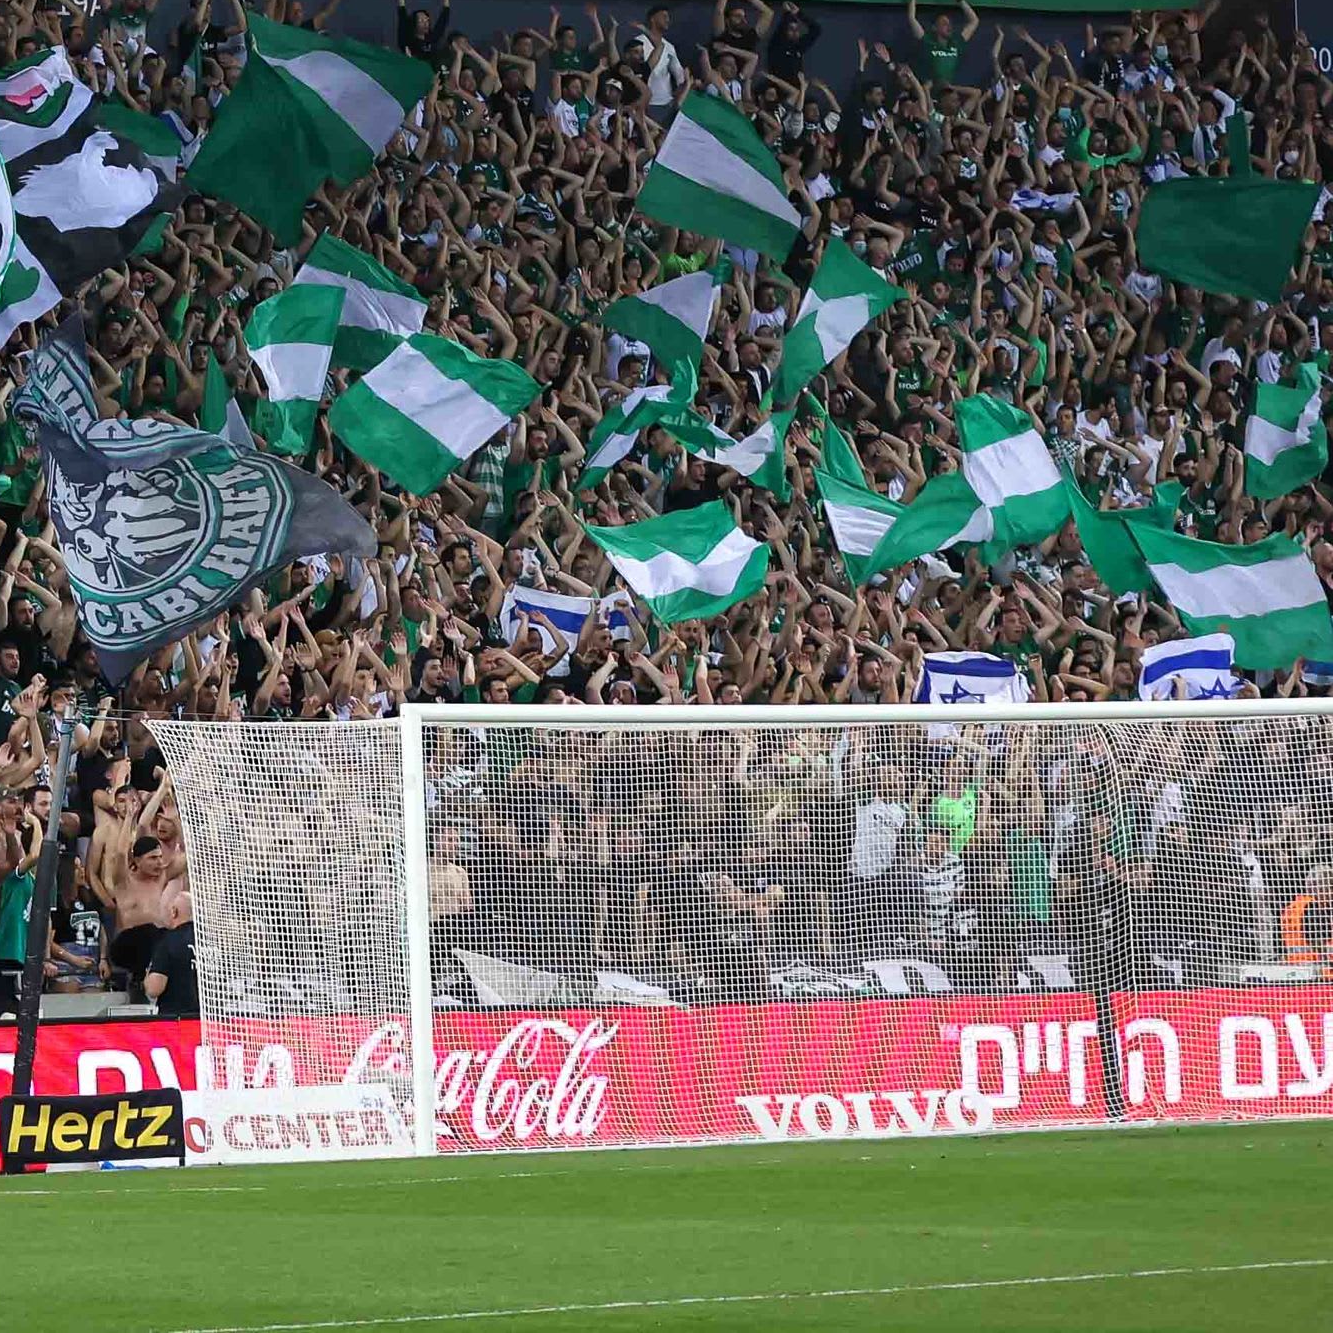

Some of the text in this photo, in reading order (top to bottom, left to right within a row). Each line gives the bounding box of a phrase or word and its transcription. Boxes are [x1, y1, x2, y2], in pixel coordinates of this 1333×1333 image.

[6, 1099, 173, 1153] Hertz
[223, 1109, 393, 1152] CENTER
[736, 1089, 995, 1139] VOLVO
